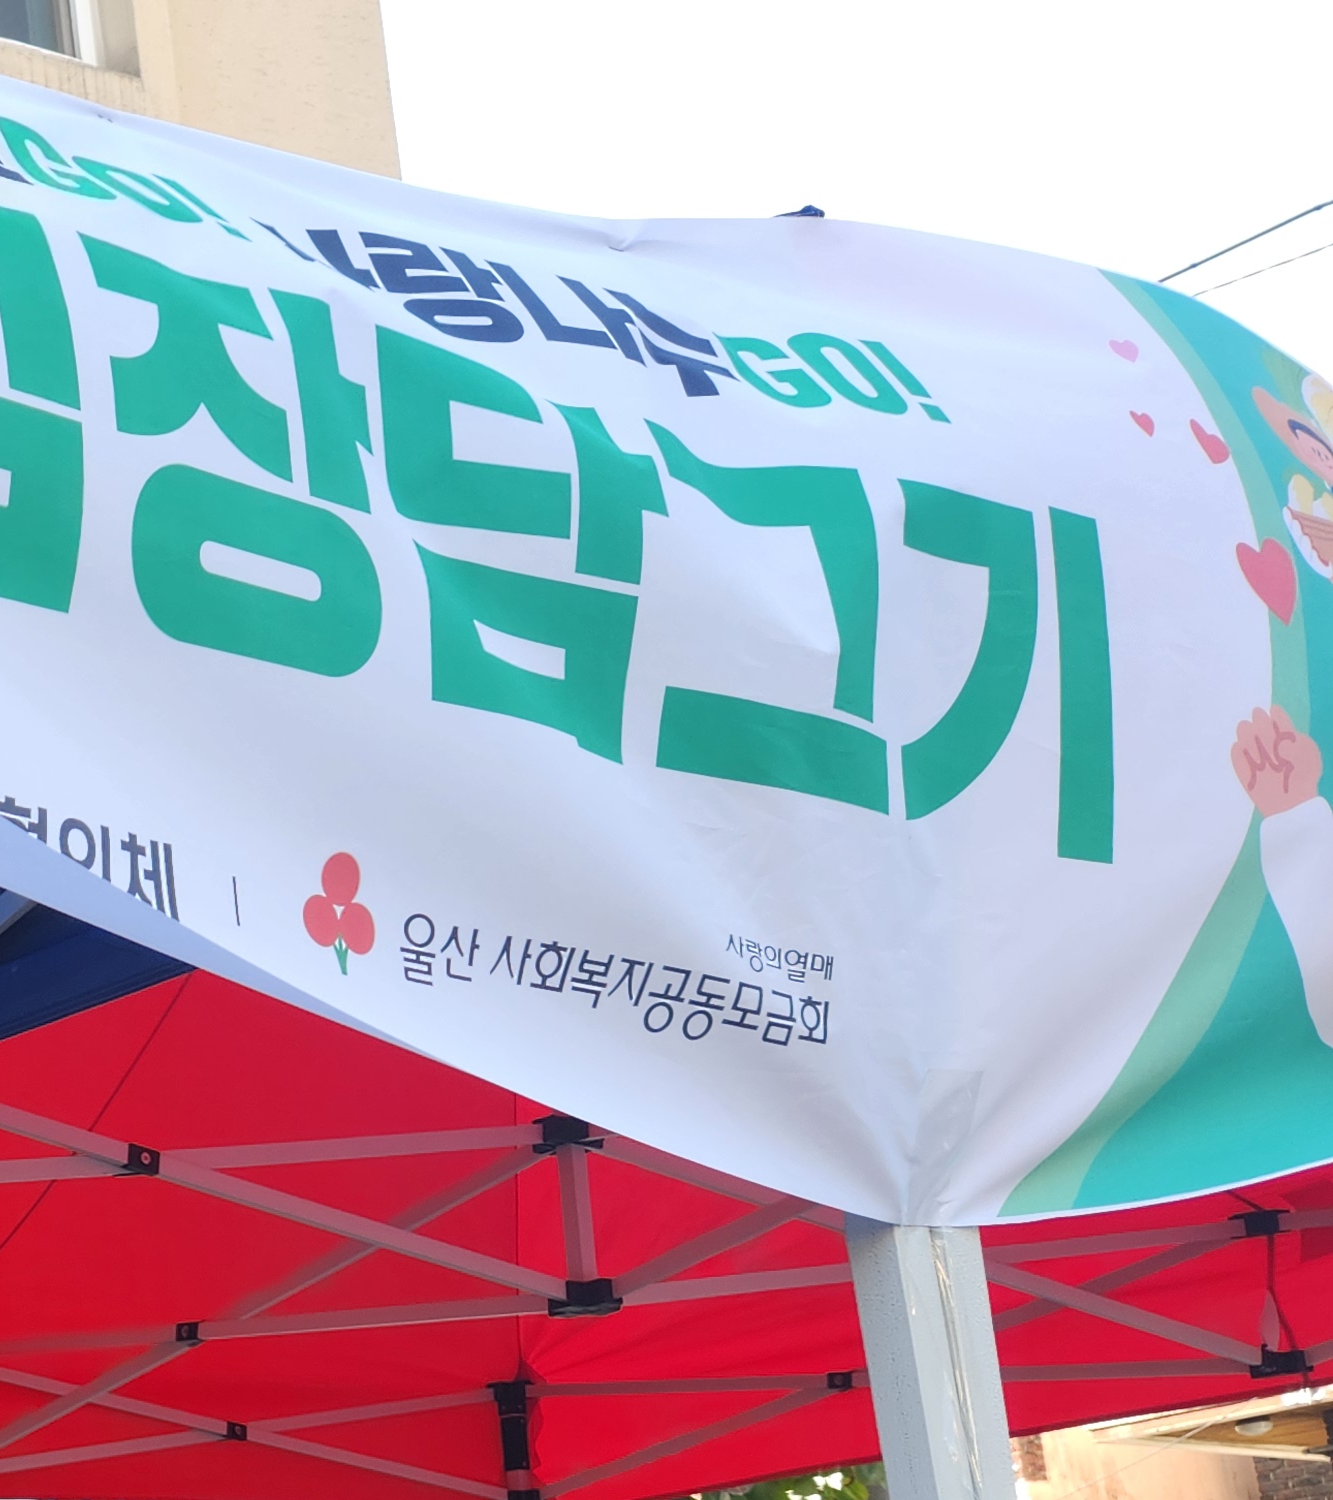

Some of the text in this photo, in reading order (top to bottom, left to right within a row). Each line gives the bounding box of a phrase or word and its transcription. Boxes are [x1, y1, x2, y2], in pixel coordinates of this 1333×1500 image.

[399, 913, 831, 1047] 울산 사회복지공동모금회
[726, 933, 835, 984] 사랑의열매
